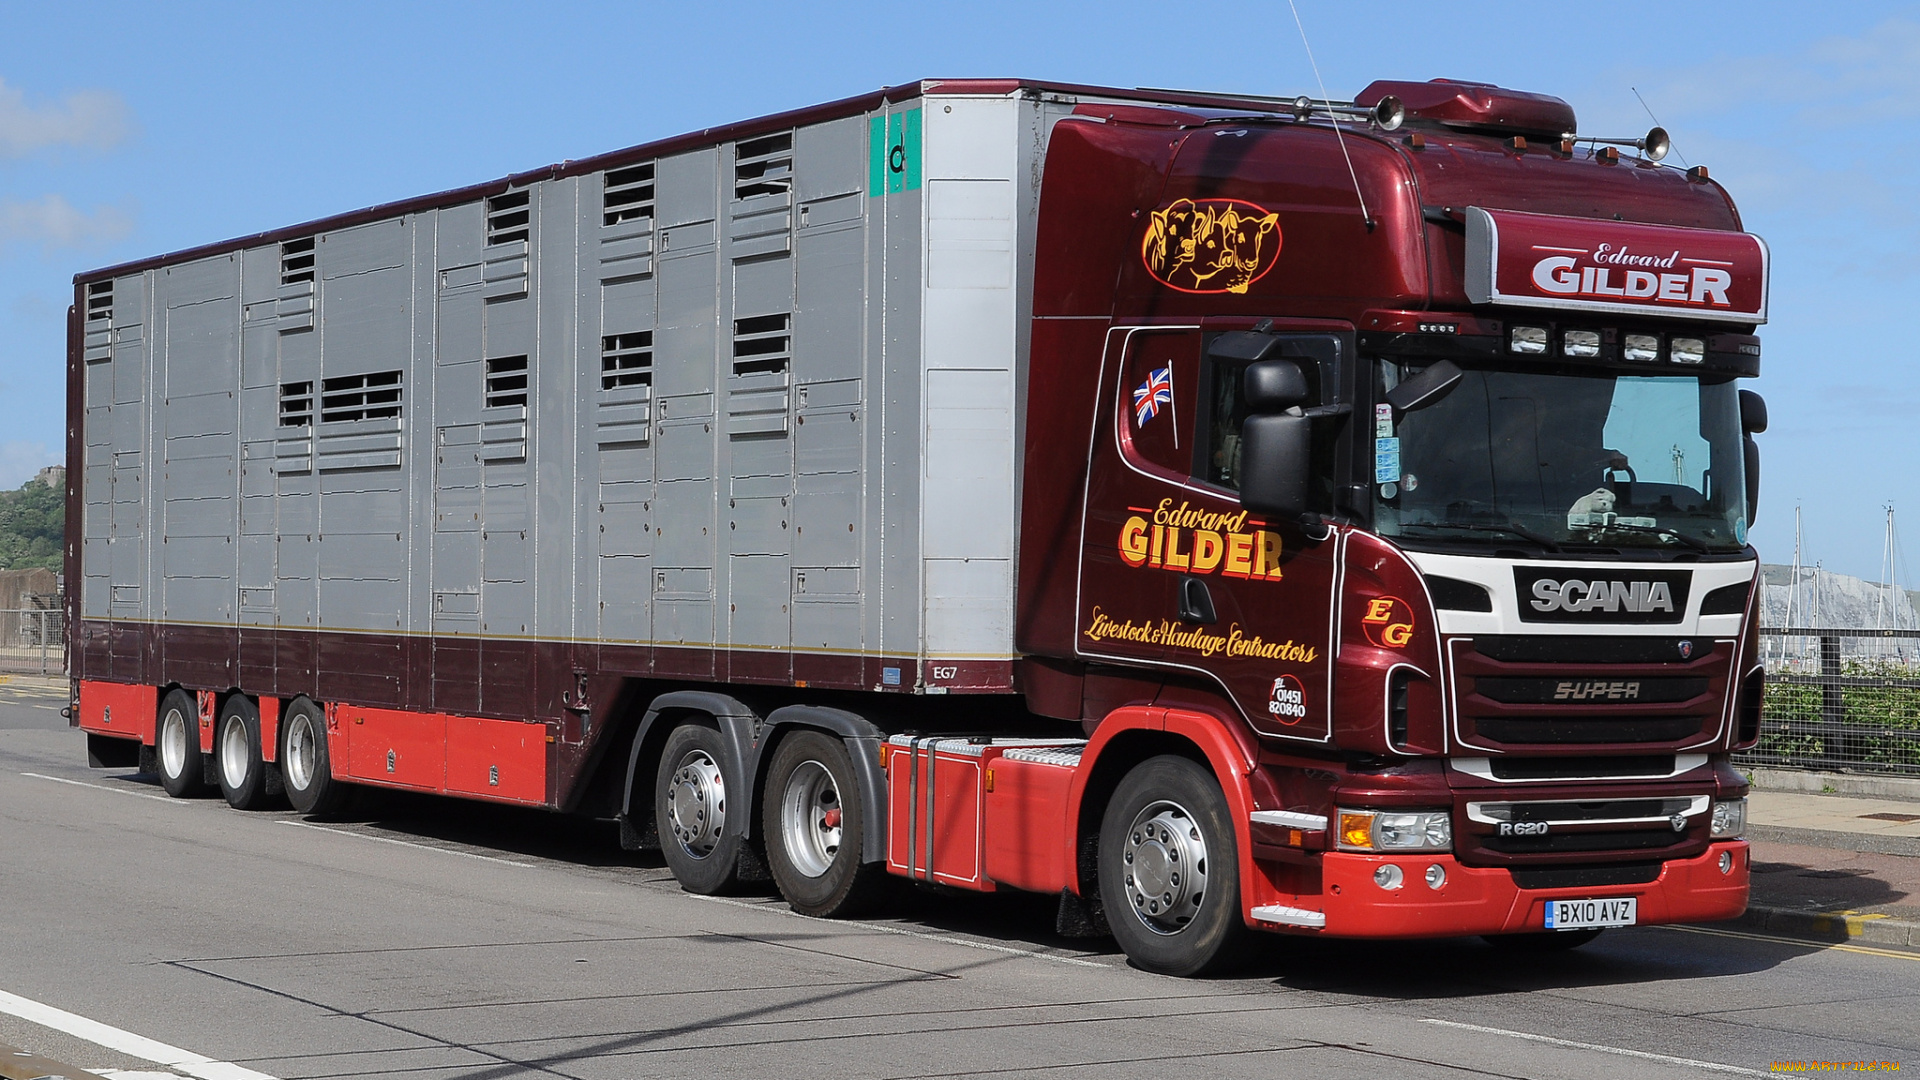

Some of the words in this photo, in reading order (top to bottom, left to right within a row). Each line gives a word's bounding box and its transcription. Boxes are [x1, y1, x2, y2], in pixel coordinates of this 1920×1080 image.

[1593, 243, 1680, 269] Edward
[1530, 256, 1731, 307] GILDER
[1153, 498, 1248, 533] Edward
[1118, 516, 1283, 582] GILDER
[1530, 578, 1674, 613] SCANIA
[1084, 606, 1152, 641] Livestock
[1160, 618, 1226, 657] Haulage
[1226, 622, 1319, 663] Contractors
[1362, 599, 1393, 625] E
[1381, 623, 1413, 648] G
[933, 666, 957, 679] EG7
[1277, 689, 1301, 704] 01451
[1554, 682, 1640, 699] SUPER
[1268, 701, 1306, 717] 820840
[1500, 823, 1512, 836] R
[1514, 821, 1549, 836] 620
[1559, 903, 1595, 923] BX10
[1600, 901, 1630, 921] AVZ
